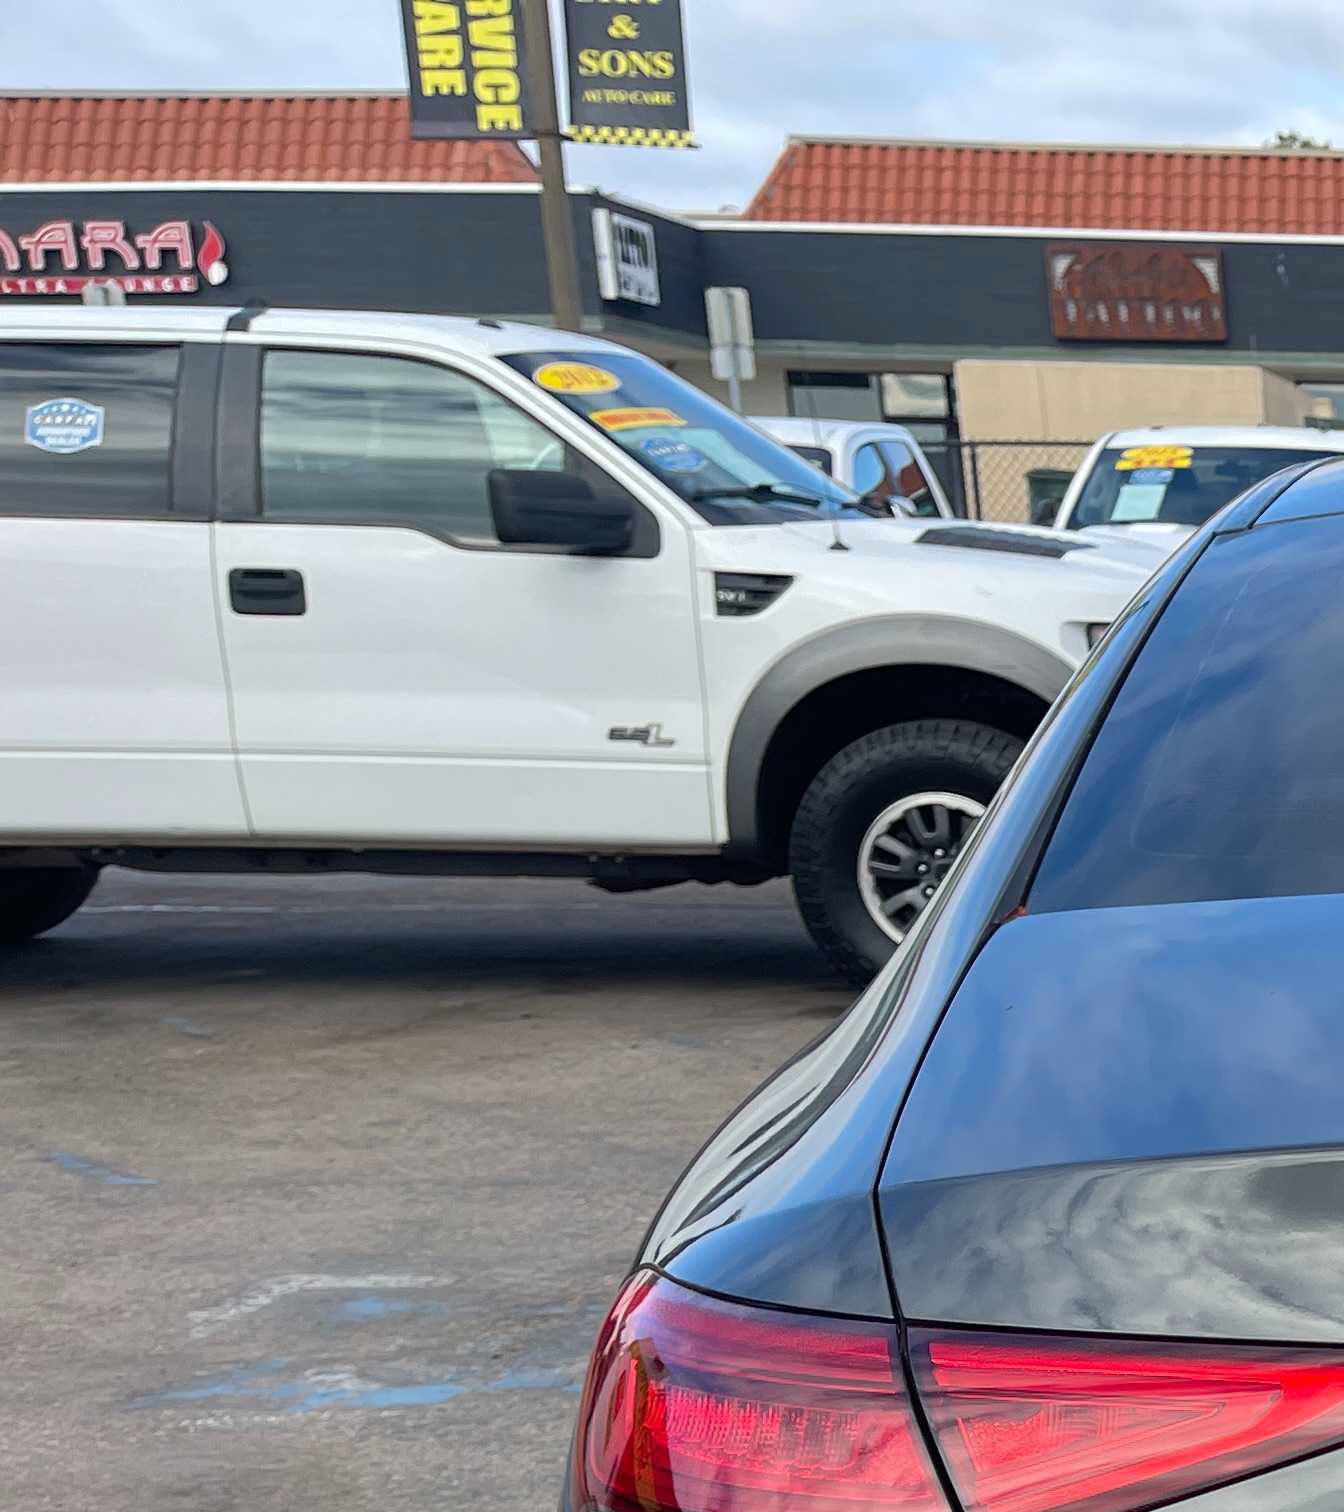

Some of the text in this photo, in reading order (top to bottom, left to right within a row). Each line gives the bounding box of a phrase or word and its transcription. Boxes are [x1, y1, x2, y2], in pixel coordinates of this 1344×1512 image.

[608, 14, 640, 39] &
[578, 48, 676, 79] SONS
[0, 220, 194, 271] ARA
